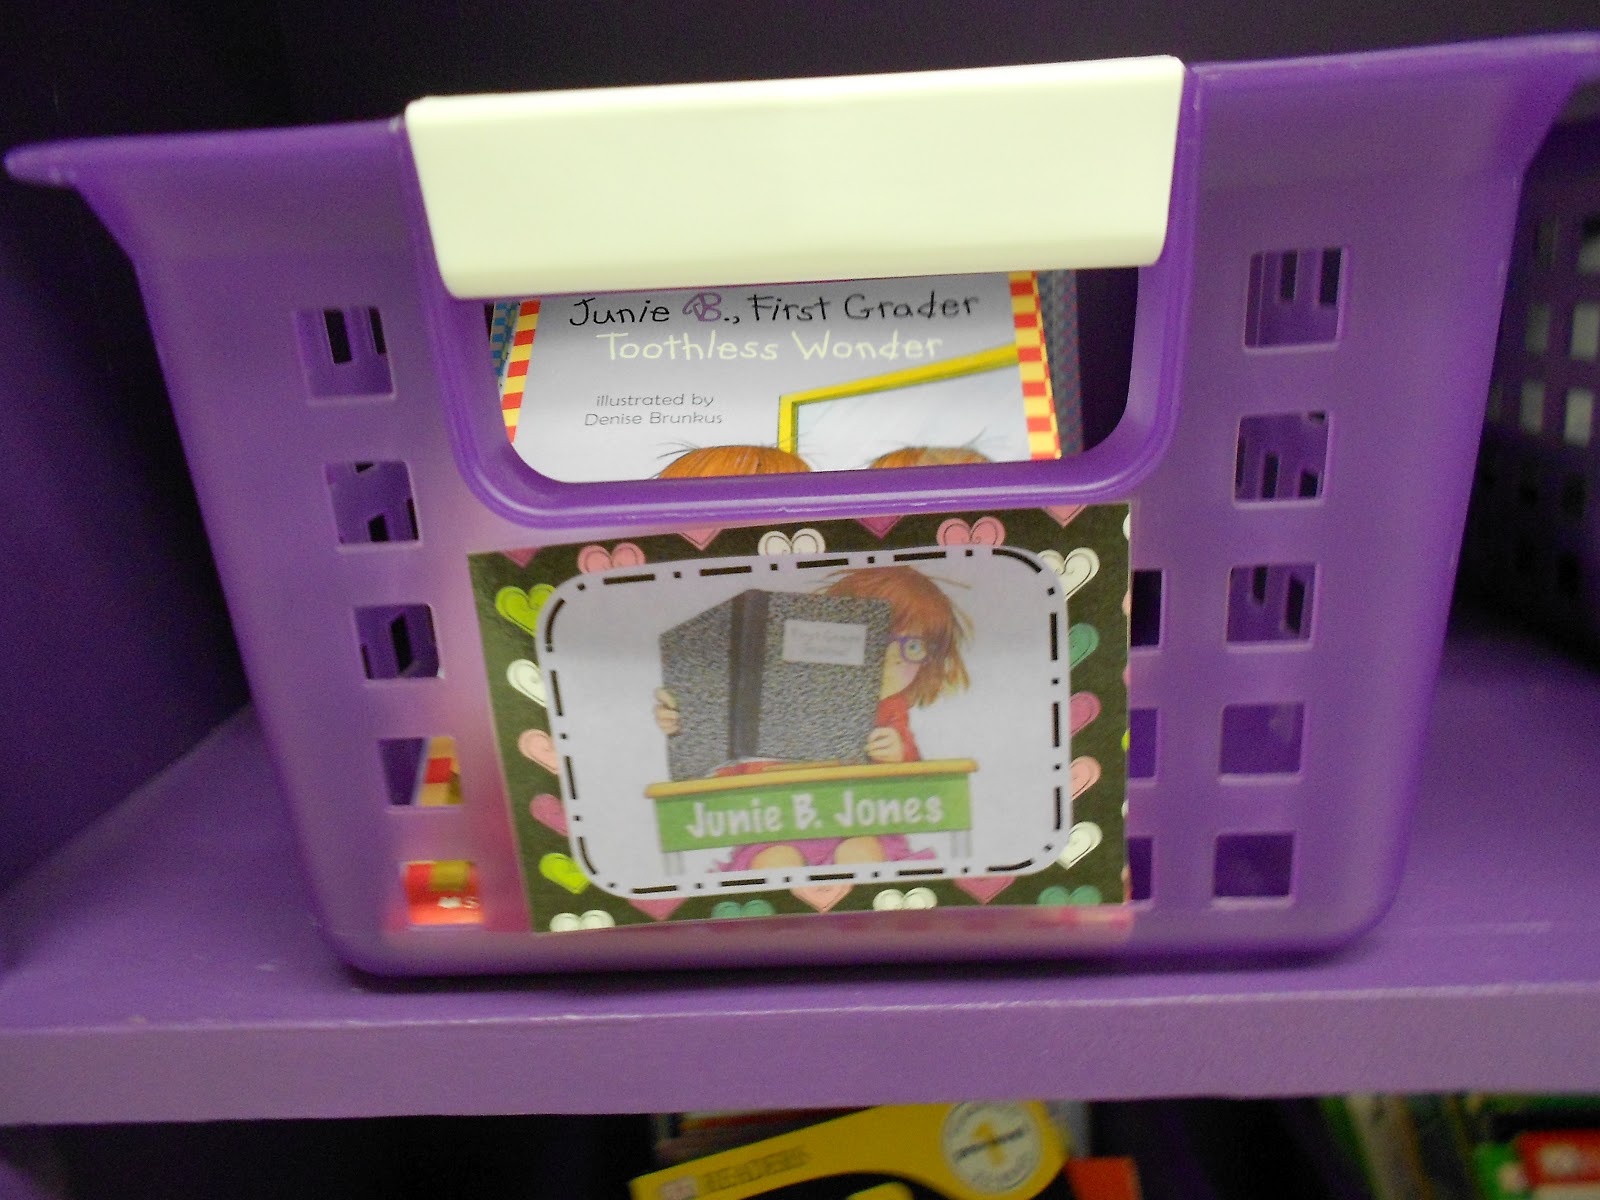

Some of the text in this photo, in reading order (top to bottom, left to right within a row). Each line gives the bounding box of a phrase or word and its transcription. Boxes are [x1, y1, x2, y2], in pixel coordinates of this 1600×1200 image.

[569, 297, 670, 326] Junie
[747, 294, 830, 321] First
[844, 289, 979, 319] Grader
[595, 328, 943, 361] Toothless Wonder
[596, 393, 714, 407] illustrated by
[584, 411, 723, 426] Denise Brunkus
[686, 790, 944, 838] Junie B. Jones
